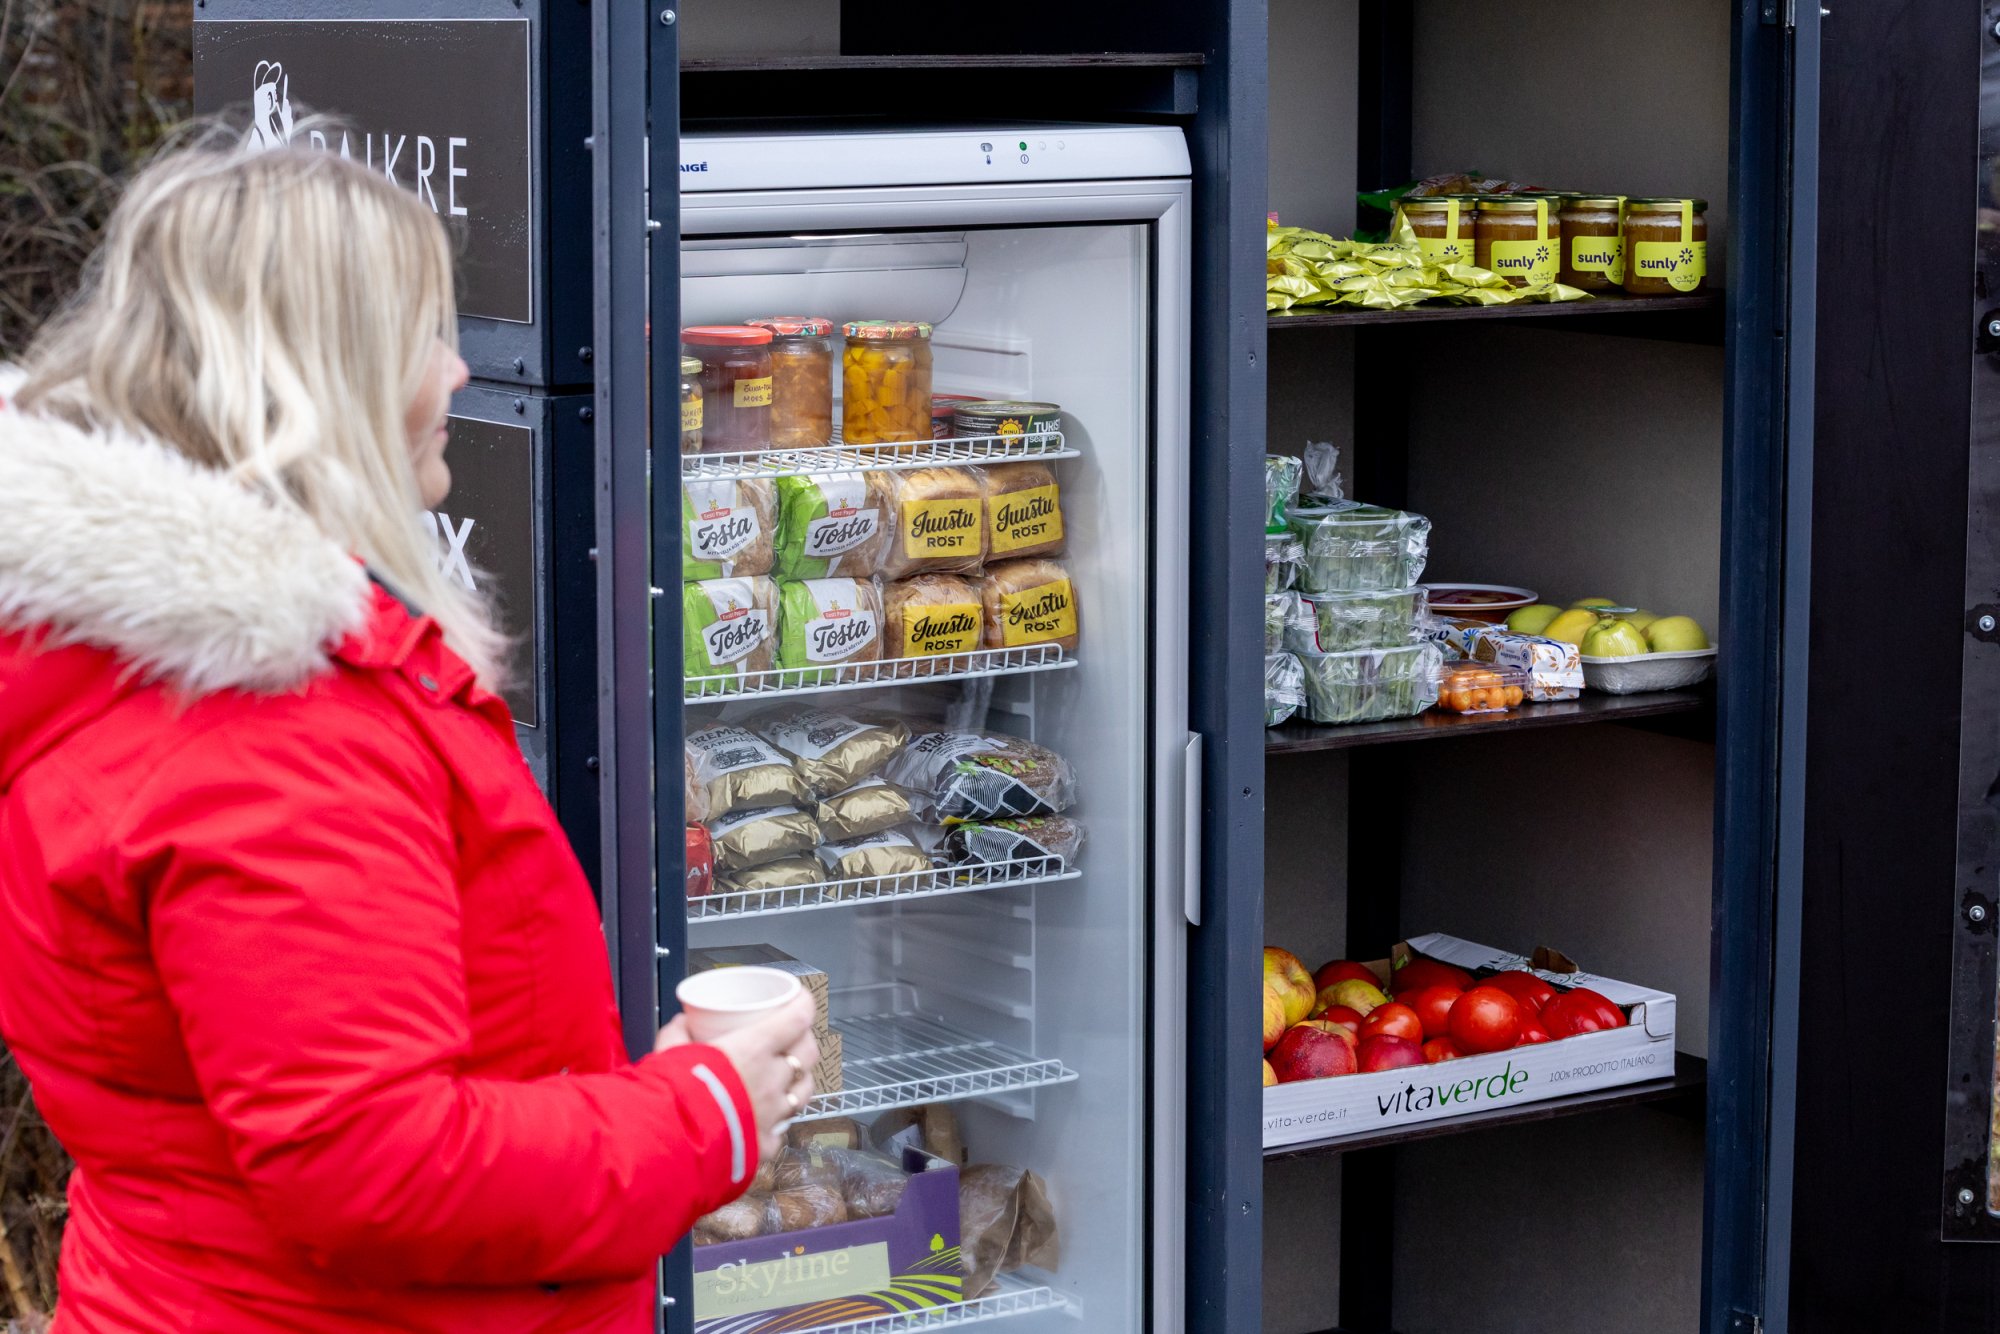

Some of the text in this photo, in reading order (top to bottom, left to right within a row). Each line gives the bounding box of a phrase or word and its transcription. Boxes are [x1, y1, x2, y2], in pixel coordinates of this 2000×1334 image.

[1497, 256, 1535, 270] sunly
[1578, 252, 1615, 266] sunly
[1641, 258, 1678, 272] sunly
[911, 508, 976, 538] Juustu
[996, 496, 1054, 532] Juustu
[697, 517, 752, 550] Tosta
[813, 517, 873, 549] Tosta
[927, 535, 964, 548] RÖST
[1012, 523, 1047, 540] RÖST
[1009, 592, 1068, 626] Juustu
[709, 617, 764, 657] Tosta
[813, 618, 871, 653] Tosta
[911, 612, 976, 643] Juustu
[1024, 618, 1060, 634] RÖST
[924, 639, 962, 651] RÖST
[1549, 1053, 1656, 1082] 100% PRODOTTO ITALIANO
[1378, 1060, 1529, 1116] vitaverde
[716, 1246, 850, 1296] Skyline
